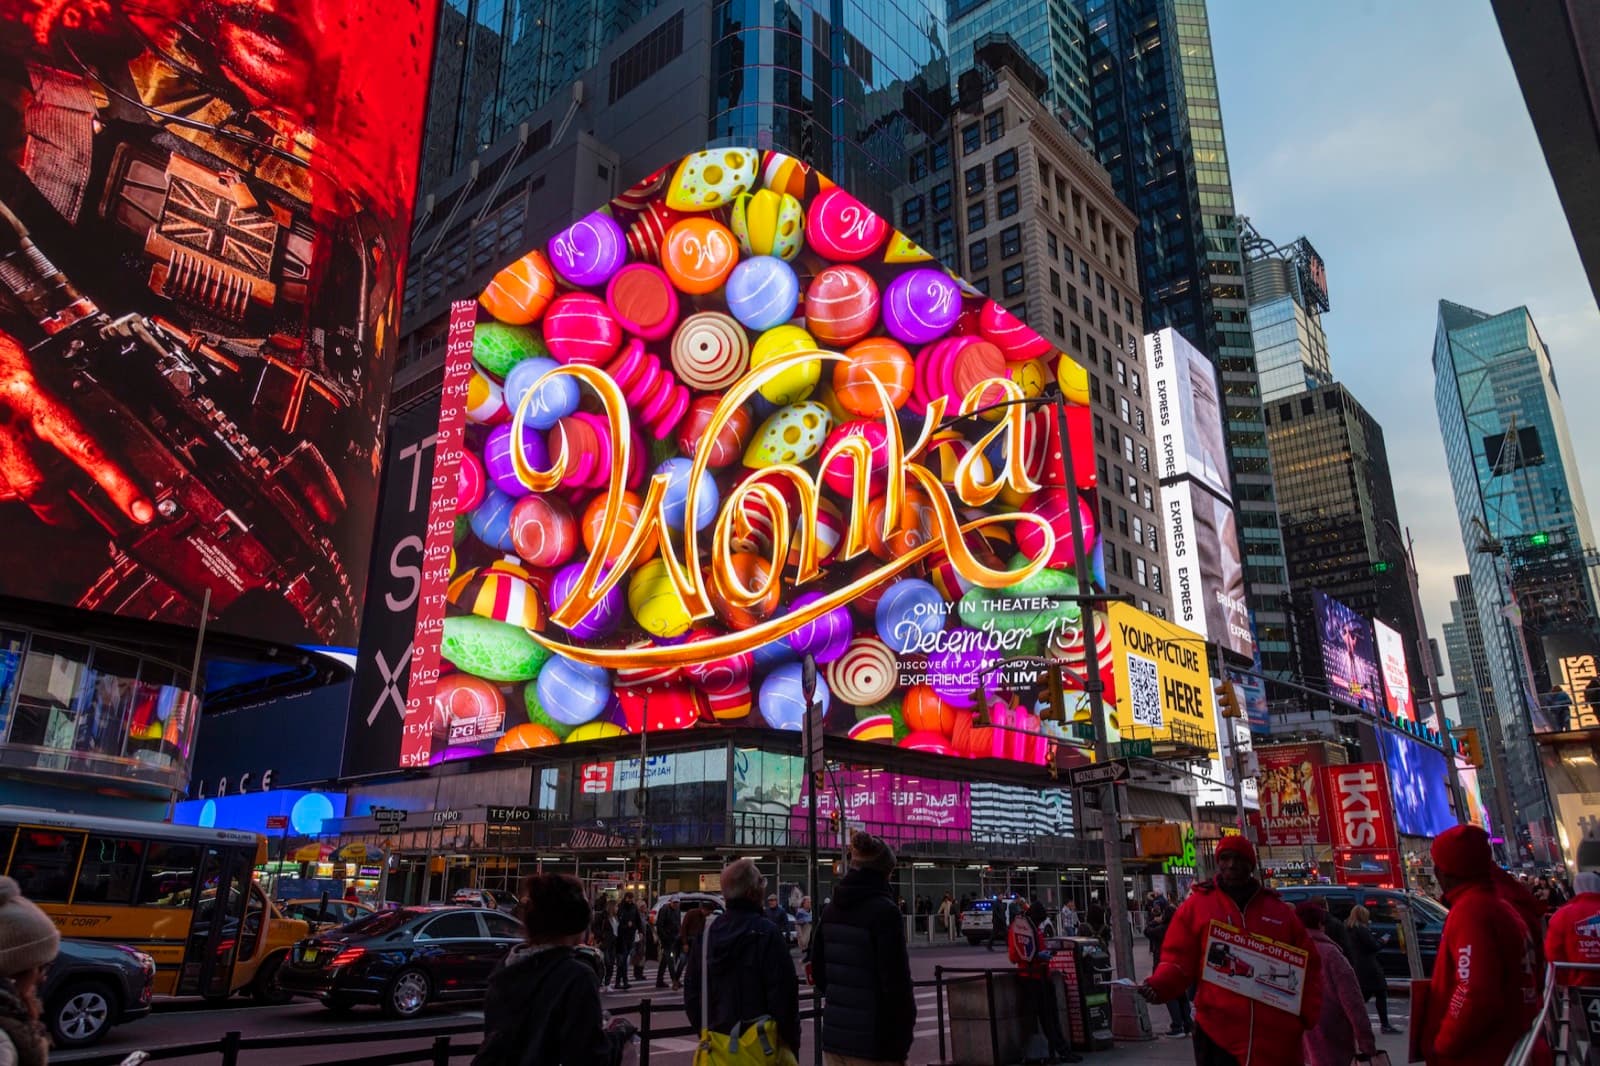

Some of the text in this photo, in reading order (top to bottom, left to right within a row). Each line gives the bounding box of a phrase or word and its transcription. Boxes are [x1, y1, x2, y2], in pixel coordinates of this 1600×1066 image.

[1157, 379, 1170, 426] EXPRESS
[509, 349, 1056, 668] Wonka
[1170, 500, 1186, 557] EXPRESS
[913, 597, 1060, 616] ONLY IN THEATERS
[1178, 567, 1193, 621] EXPRESS
[894, 617, 1079, 655] December 15
[1119, 622, 1199, 672] YOUR PICTURE
[895, 660, 947, 670] DISCOVER
[963, 660, 976, 668] AT
[900, 673, 979, 685] EXPERIENCE
[997, 672, 1010, 683] IN
[1163, 676, 1204, 718] HERE
[451, 725, 474, 738] PG
[180, 769, 272, 802] LACE
[1079, 766, 1120, 781] ONE WAY
[433, 808, 458, 825] TEMPO
[491, 807, 531, 825] TEMPO
[1261, 816, 1321, 829] HARMONY
[1338, 769, 1380, 847] tkts
[72, 918, 100, 927] CORP
[1213, 927, 1246, 945] Hop-On
[1247, 939, 1283, 956] Hop-Off
[1283, 952, 1304, 965] Pass
